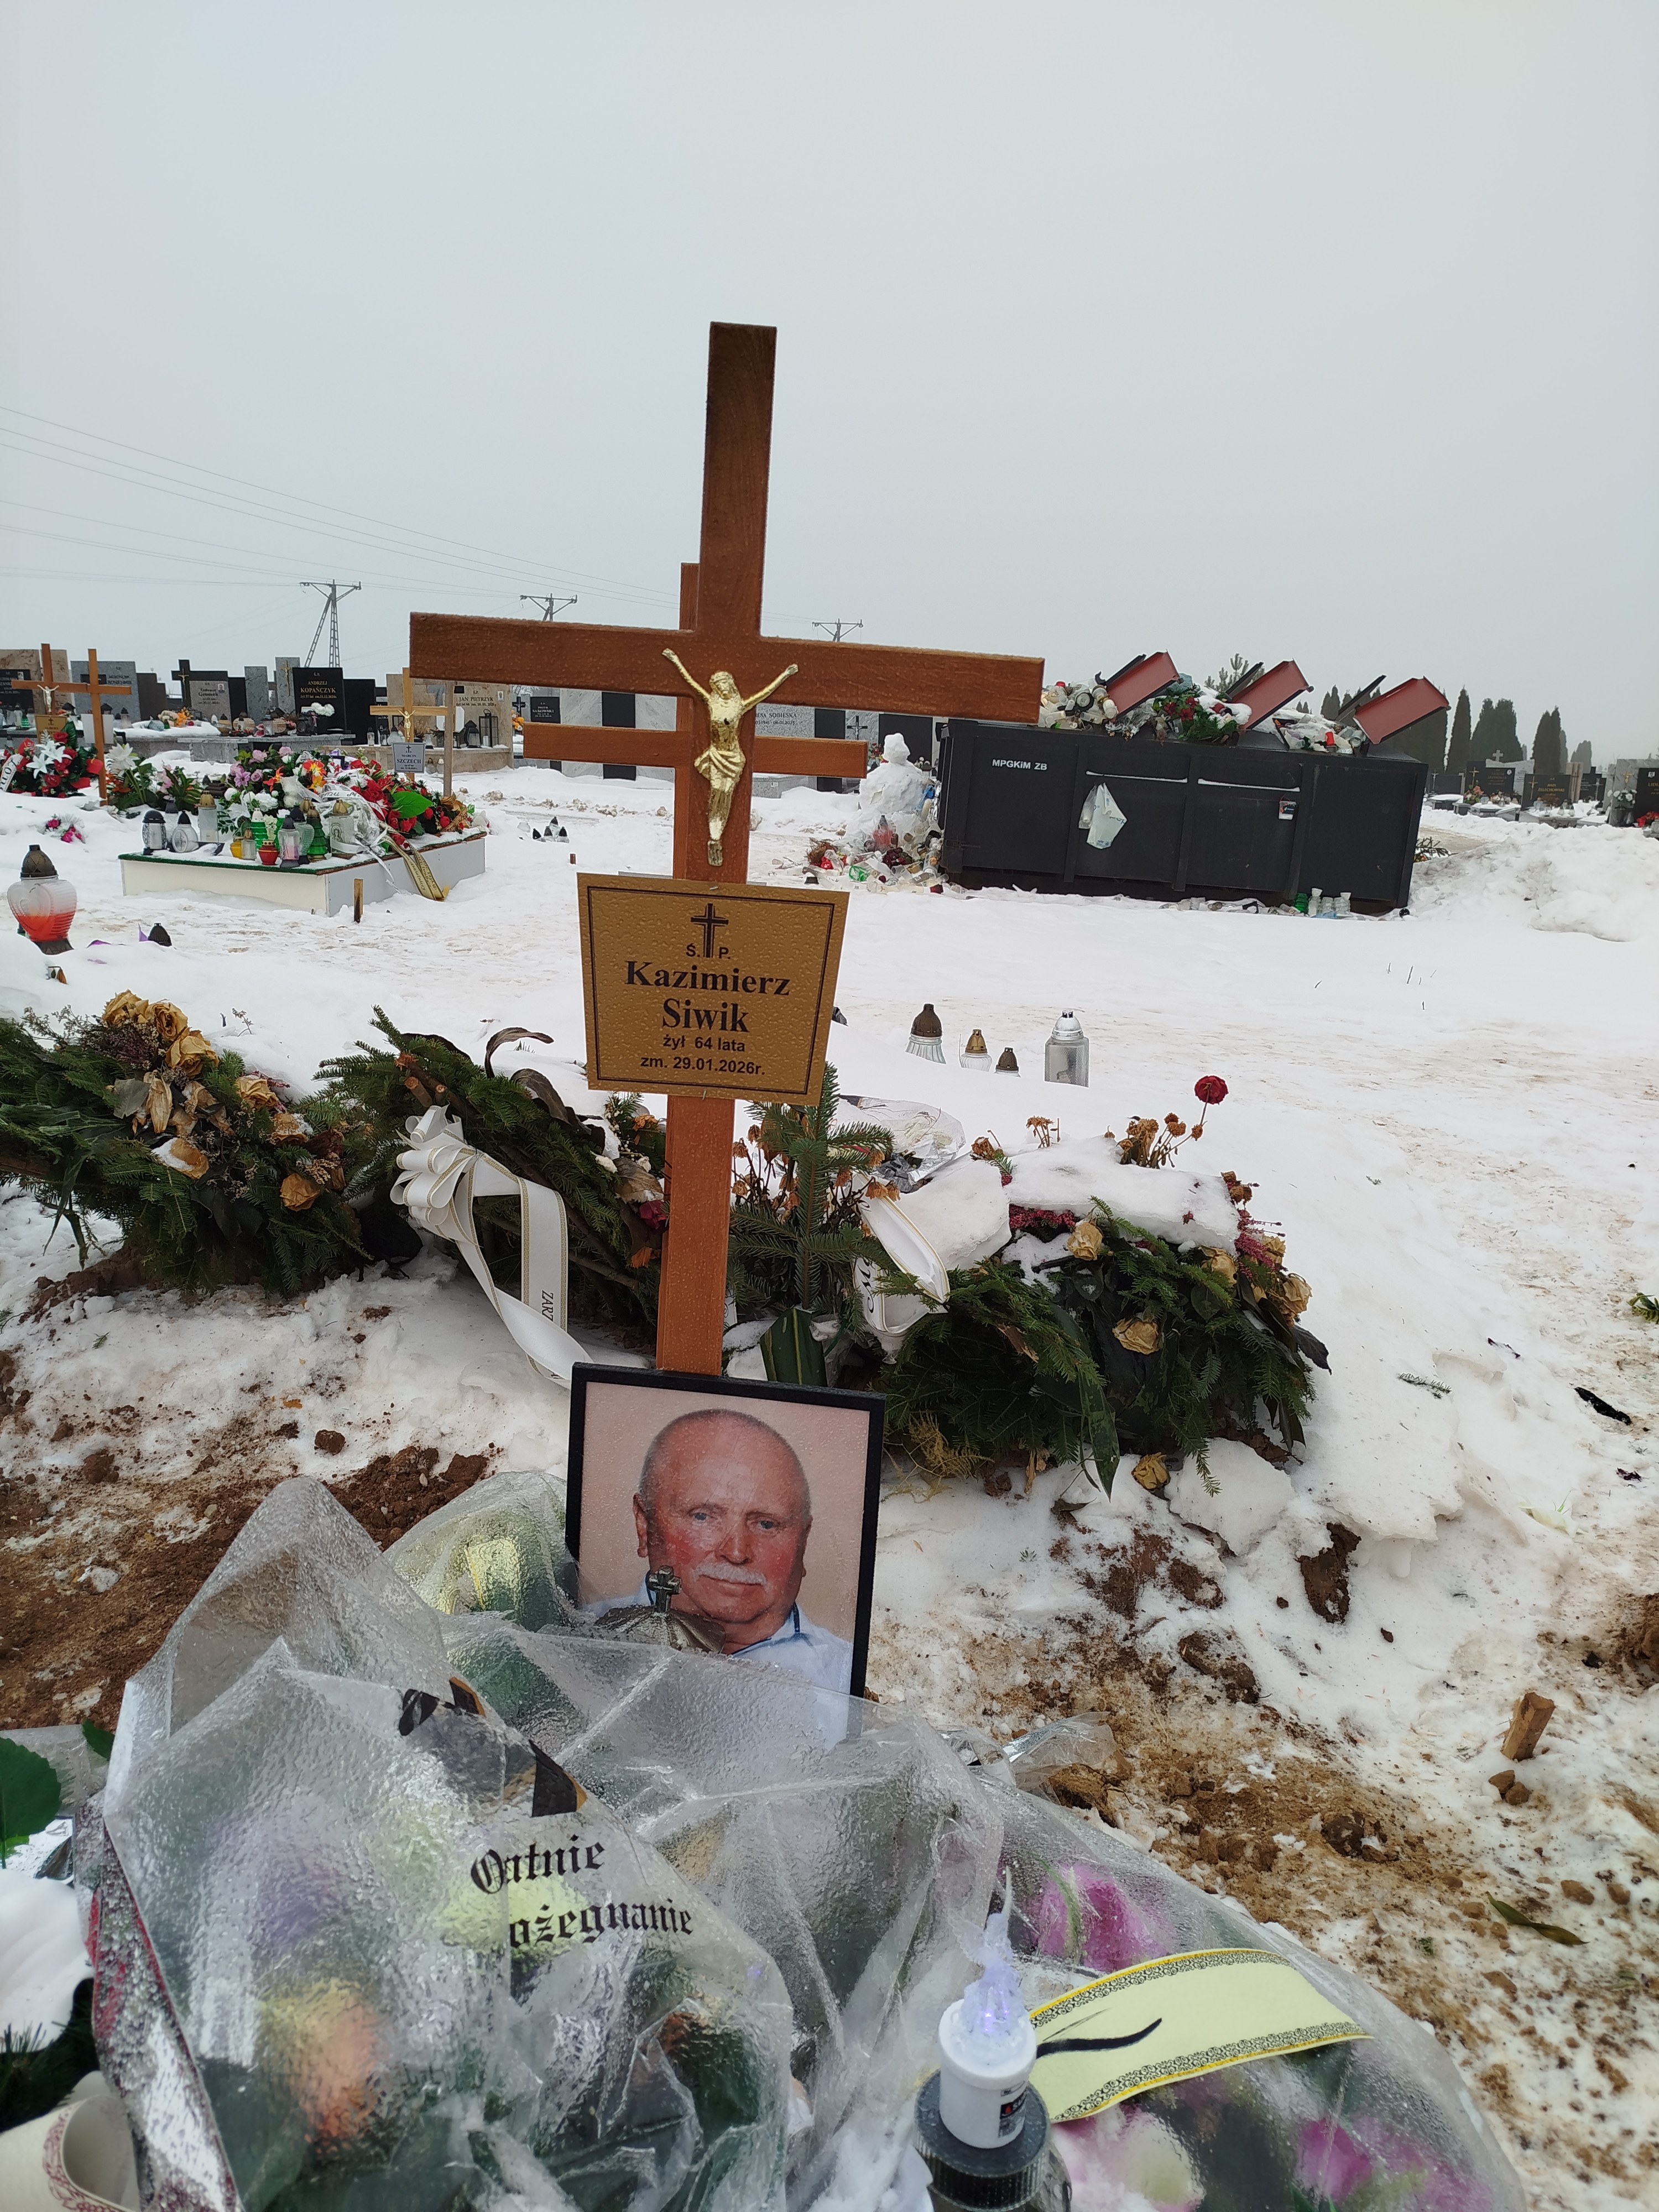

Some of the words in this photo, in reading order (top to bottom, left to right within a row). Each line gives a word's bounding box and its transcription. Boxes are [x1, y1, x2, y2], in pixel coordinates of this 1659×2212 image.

[992, 759, 1031, 769] MPGKiM
[625, 960, 791, 996] Kazimierz
[662, 998, 749, 1033] Siwik
[663, 1035, 686, 1050] żył
[695, 1037, 713, 1050] 64
[718, 1037, 746, 1052] lata
[640, 1057, 668, 1069] zm.
[672, 1057, 766, 1076] 29.01.2026r.
[509, 1898, 693, 1948] ożegnanie
